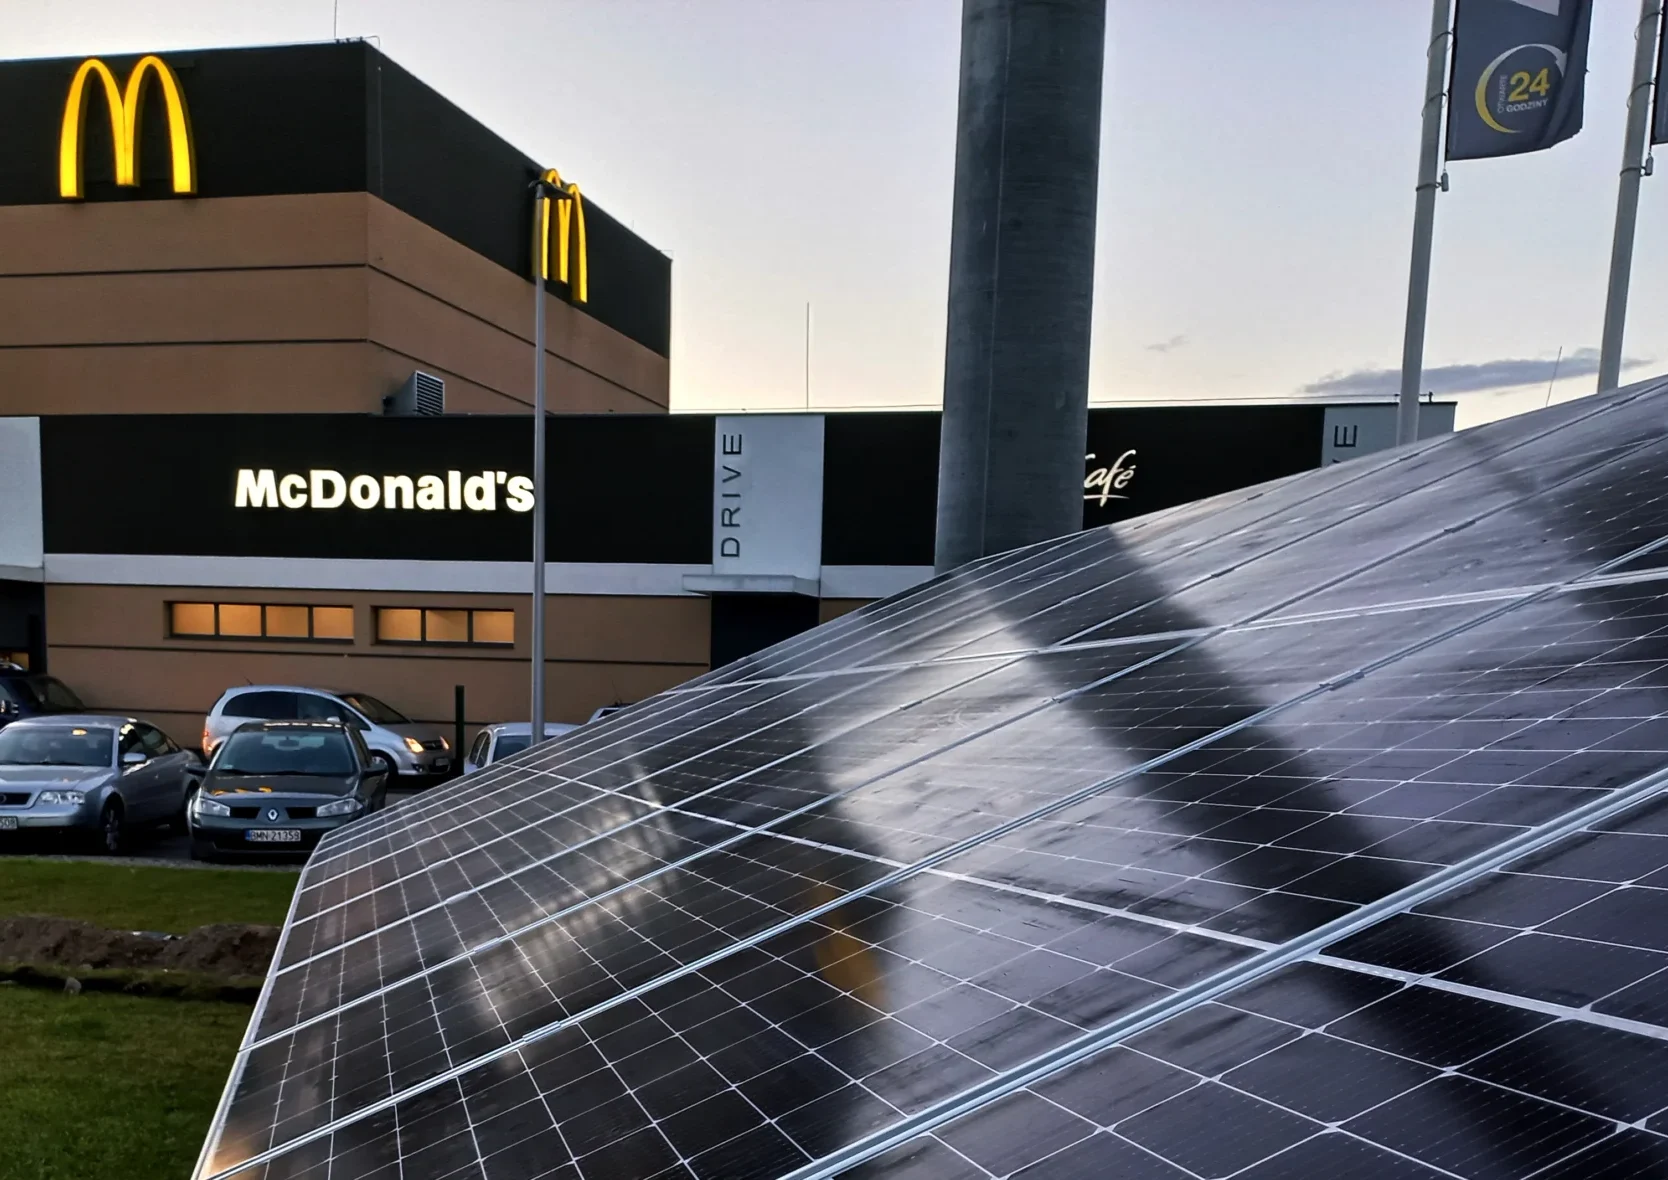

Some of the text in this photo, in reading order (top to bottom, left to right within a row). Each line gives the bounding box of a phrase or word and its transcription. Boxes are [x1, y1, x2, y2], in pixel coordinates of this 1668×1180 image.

[1506, 98, 1549, 113] GODZINY
[1508, 67, 1550, 102] 24
[234, 468, 536, 512] McDonald's
[720, 433, 743, 558] DRIVE
[1083, 448, 1137, 508] afé
